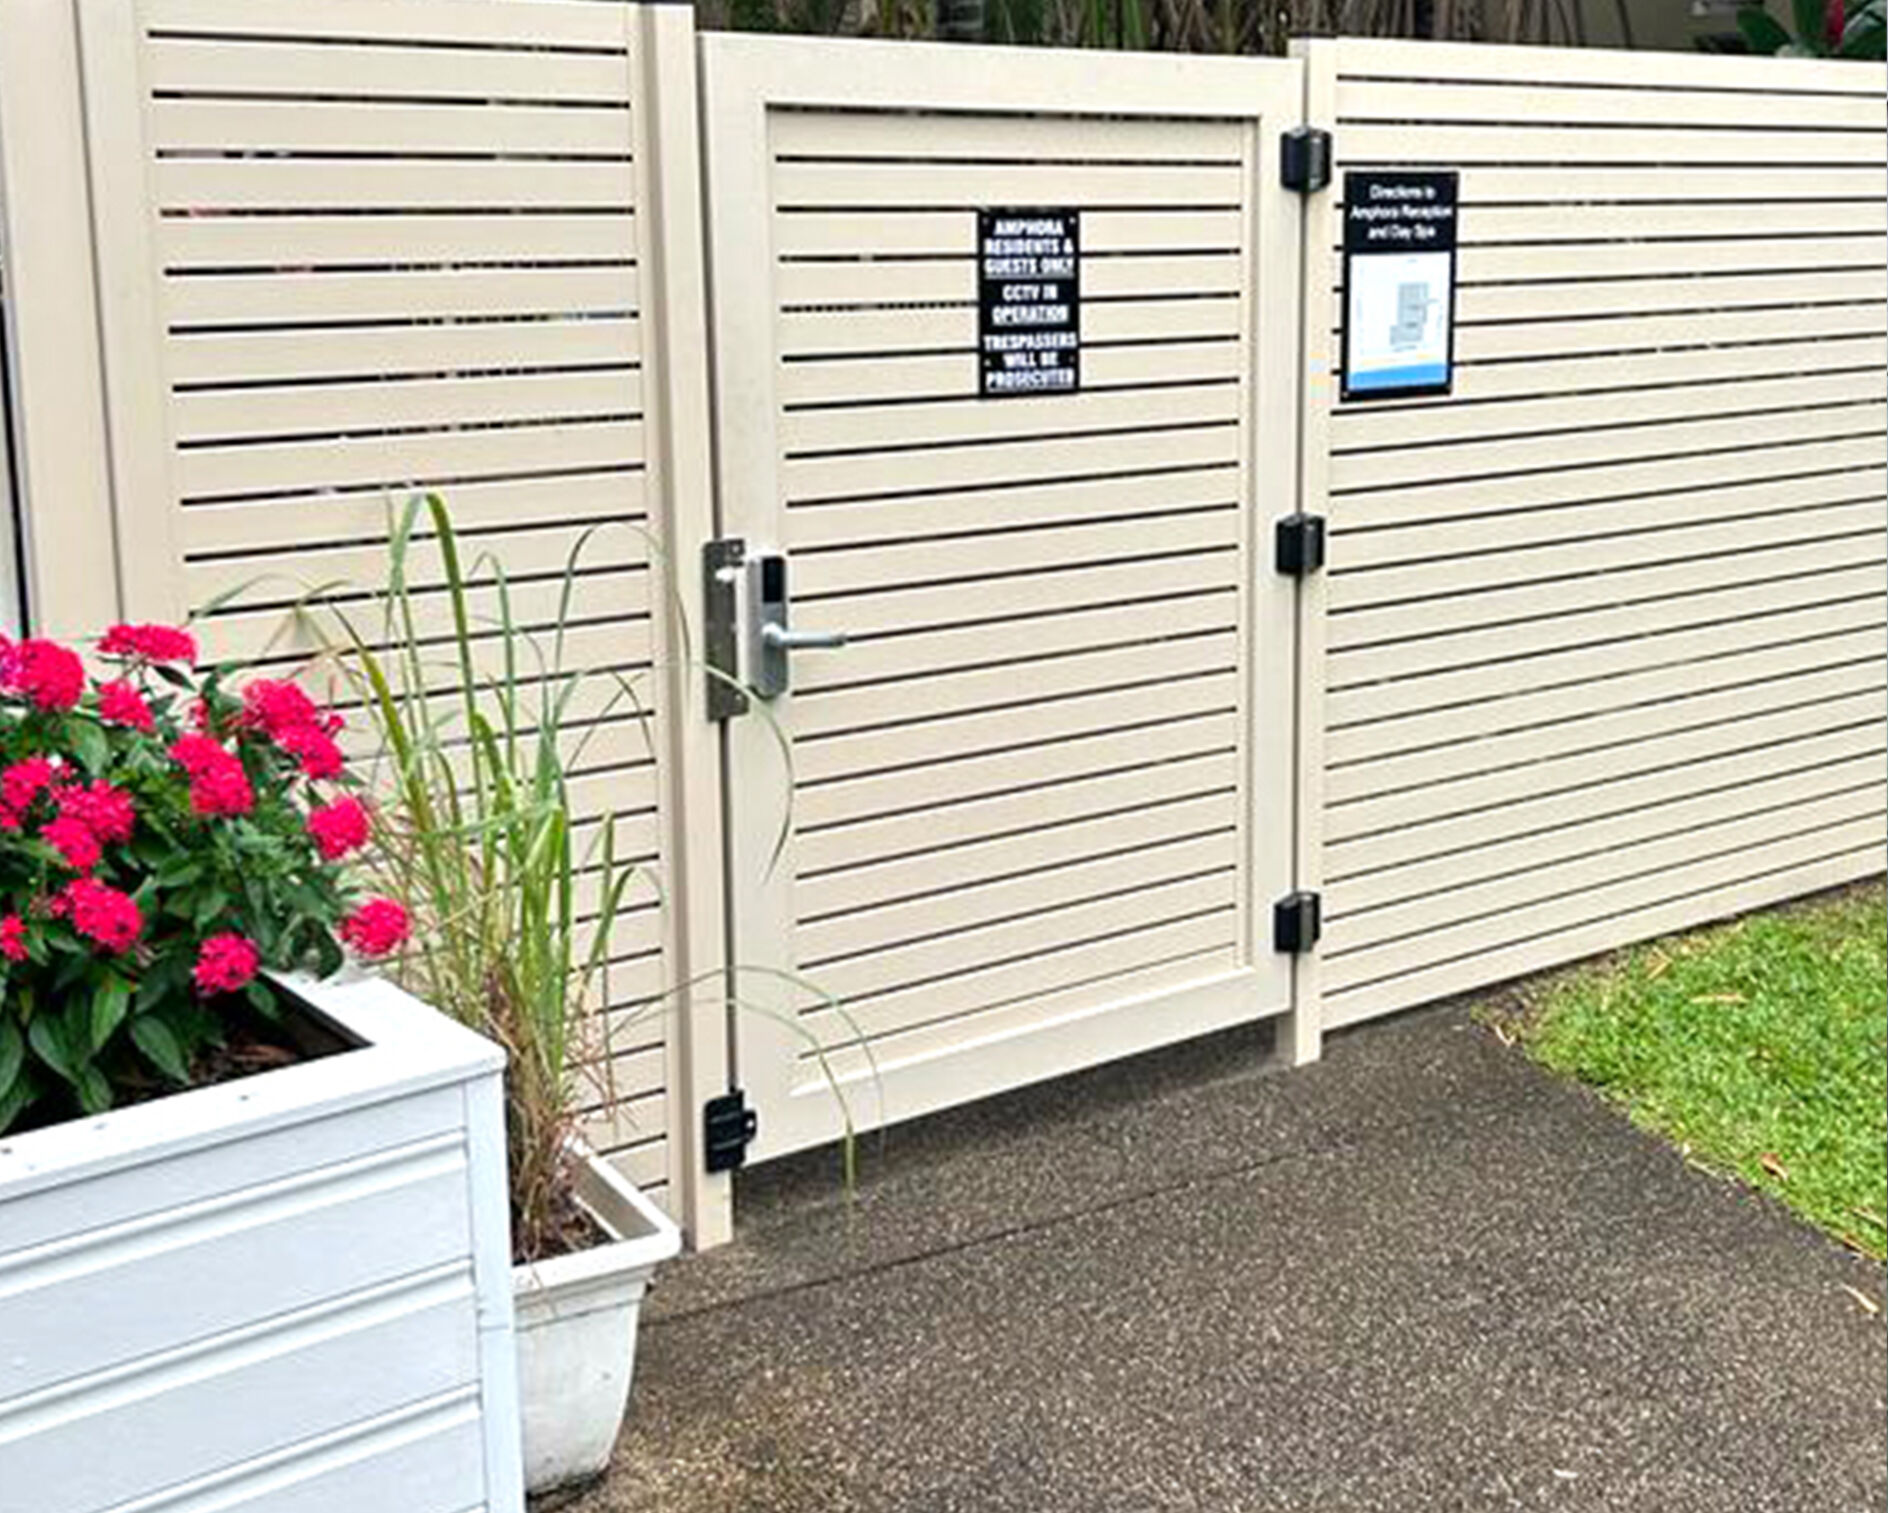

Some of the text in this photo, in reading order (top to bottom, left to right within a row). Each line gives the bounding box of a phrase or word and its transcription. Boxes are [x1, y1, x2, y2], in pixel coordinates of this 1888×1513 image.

[1369, 183, 1423, 199] Directions
[1349, 204, 1453, 221] Amphora Reception
[993, 218, 1065, 236] AMPHORA
[1368, 223, 1436, 240] and Day Spa
[983, 237, 1074, 255] RESIDENTS &
[984, 256, 1075, 279] GUESTS ONLY
[1002, 284, 1058, 301] CCTV IN
[991, 303, 1068, 325] OPERATION
[982, 332, 1077, 351] TRESPASSERS
[1003, 351, 1058, 368] WILL BE
[985, 368, 1075, 392] PROSECUTED
